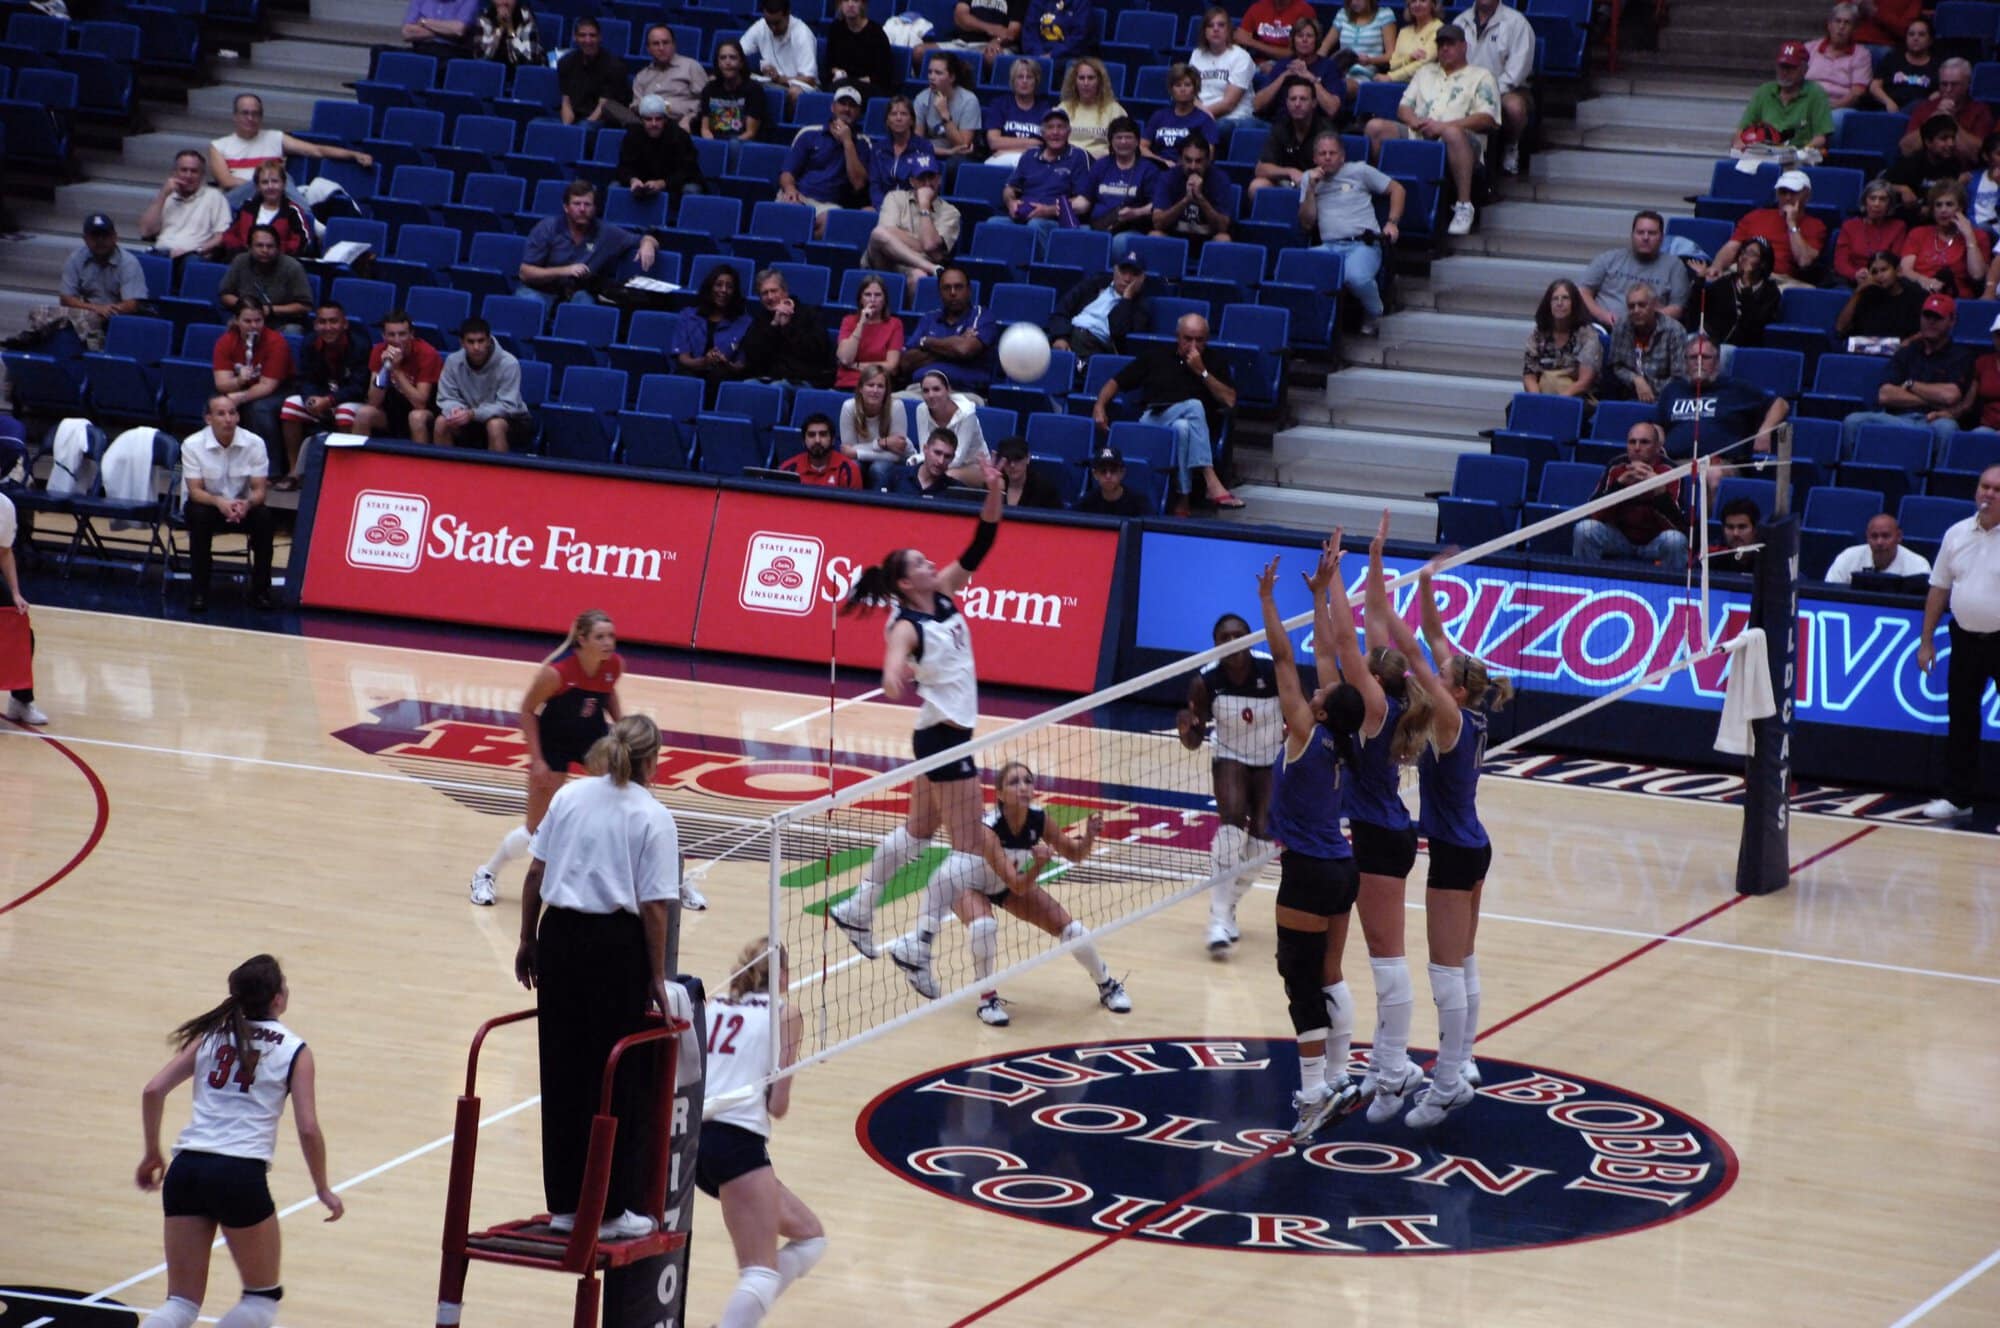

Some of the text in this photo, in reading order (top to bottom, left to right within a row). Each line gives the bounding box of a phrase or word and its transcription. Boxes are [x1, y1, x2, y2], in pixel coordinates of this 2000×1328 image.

[1672, 398, 1718, 415] UMC
[366, 501, 418, 513] STATE FARM
[357, 548, 411, 560] INSURANCE
[427, 513, 535, 567] State
[540, 524, 662, 581] Farm
[760, 543, 812, 555] STATE FARM
[750, 590, 804, 602] INSURANCE
[955, 576, 1062, 627] arm
[1767, 552, 1799, 831] WILDCATS
[707, 1013, 744, 1055] 12
[208, 1043, 260, 1094] 34
[913, 1042, 1271, 1107] LUTE
[1031, 1103, 1558, 1196] OLSON
[1475, 1072, 1711, 1207] BOBBI
[906, 1145, 1452, 1250] COURT
